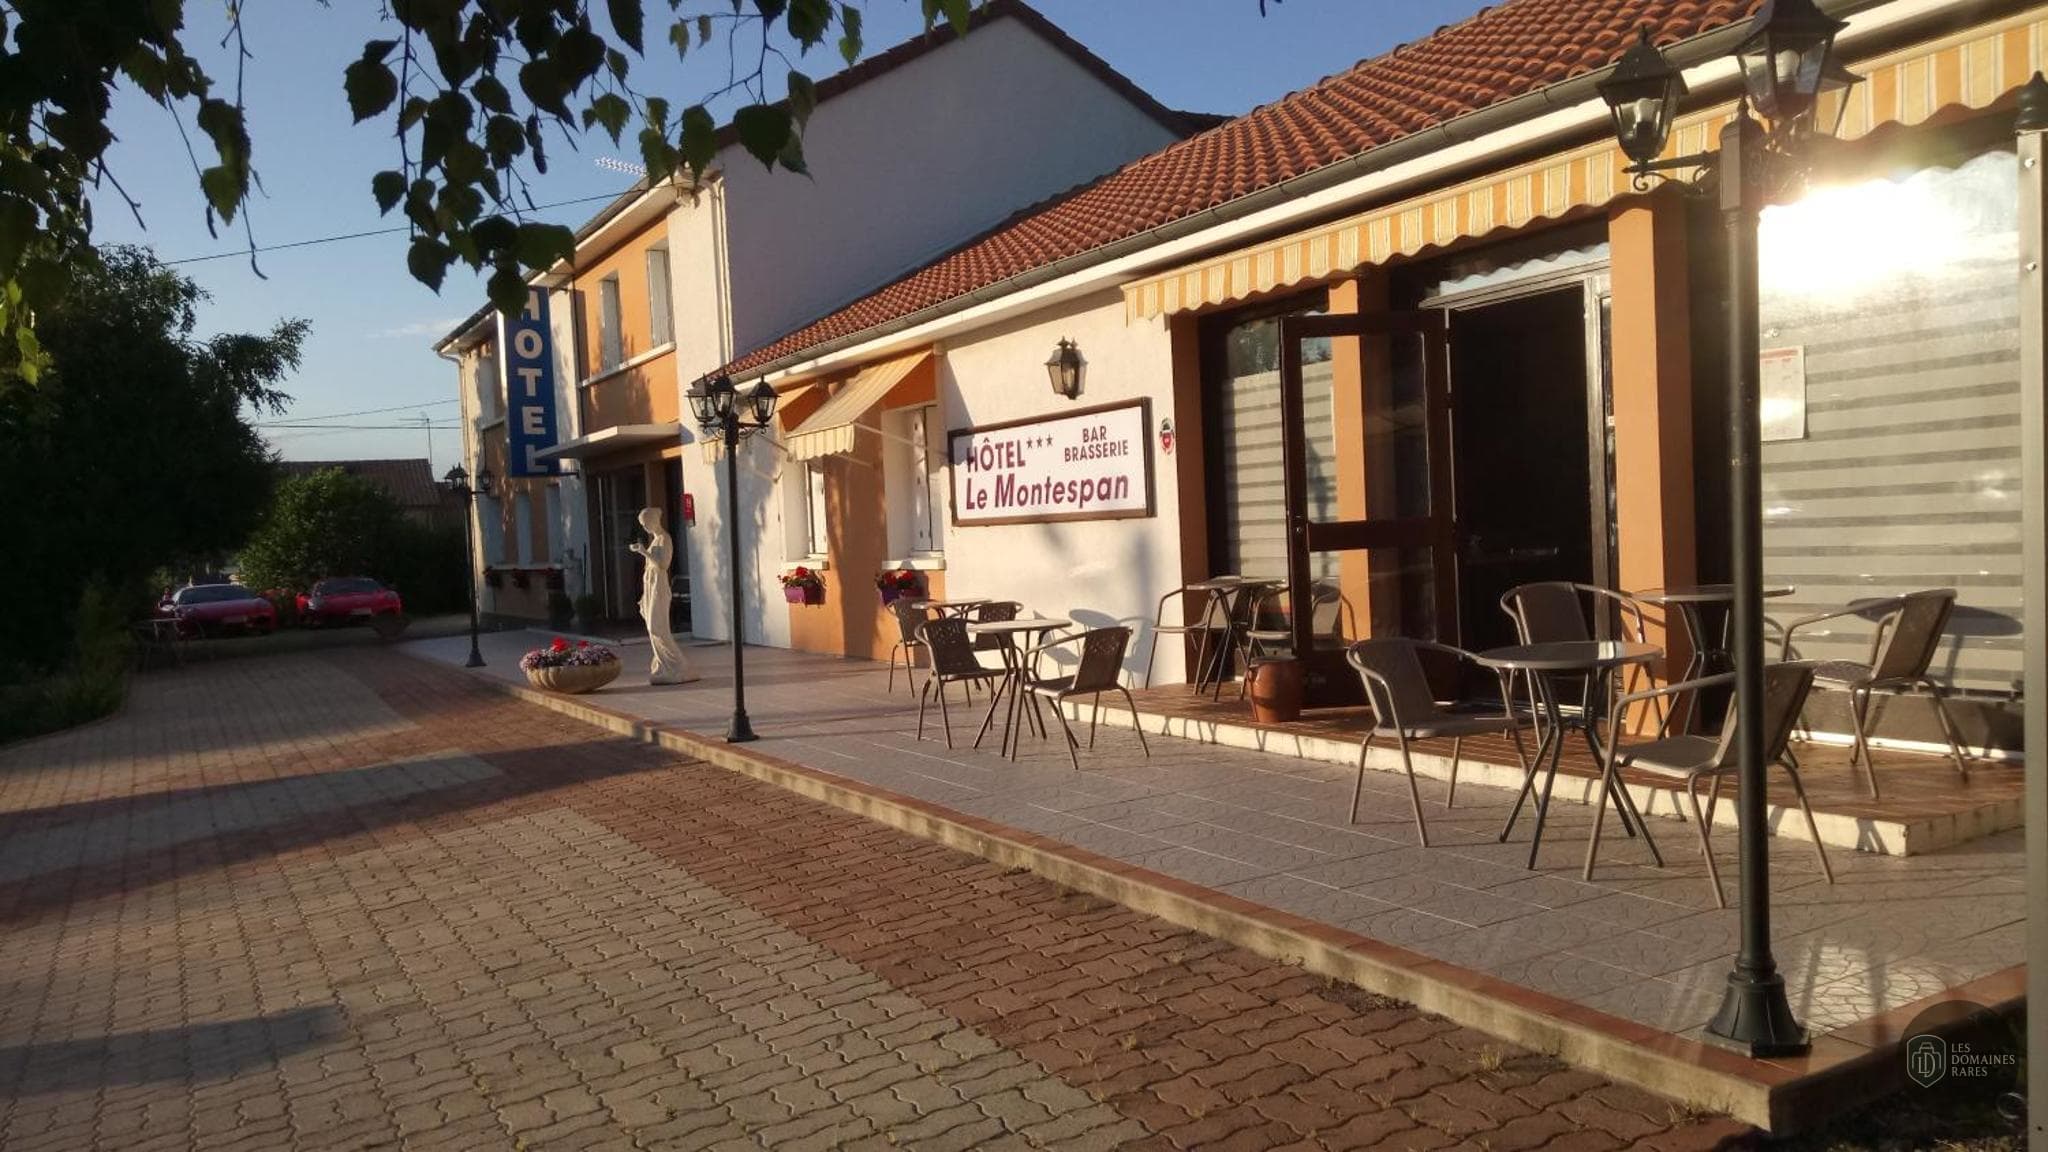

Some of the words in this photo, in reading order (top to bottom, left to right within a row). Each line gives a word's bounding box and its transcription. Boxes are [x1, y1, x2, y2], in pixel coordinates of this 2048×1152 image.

[1082, 425, 1107, 443] BAR
[966, 437, 1026, 473] HÔTEL
[1064, 439, 1129, 463] BRASSERIE
[966, 477, 988, 510] Le
[994, 473, 1129, 509] Montespan
